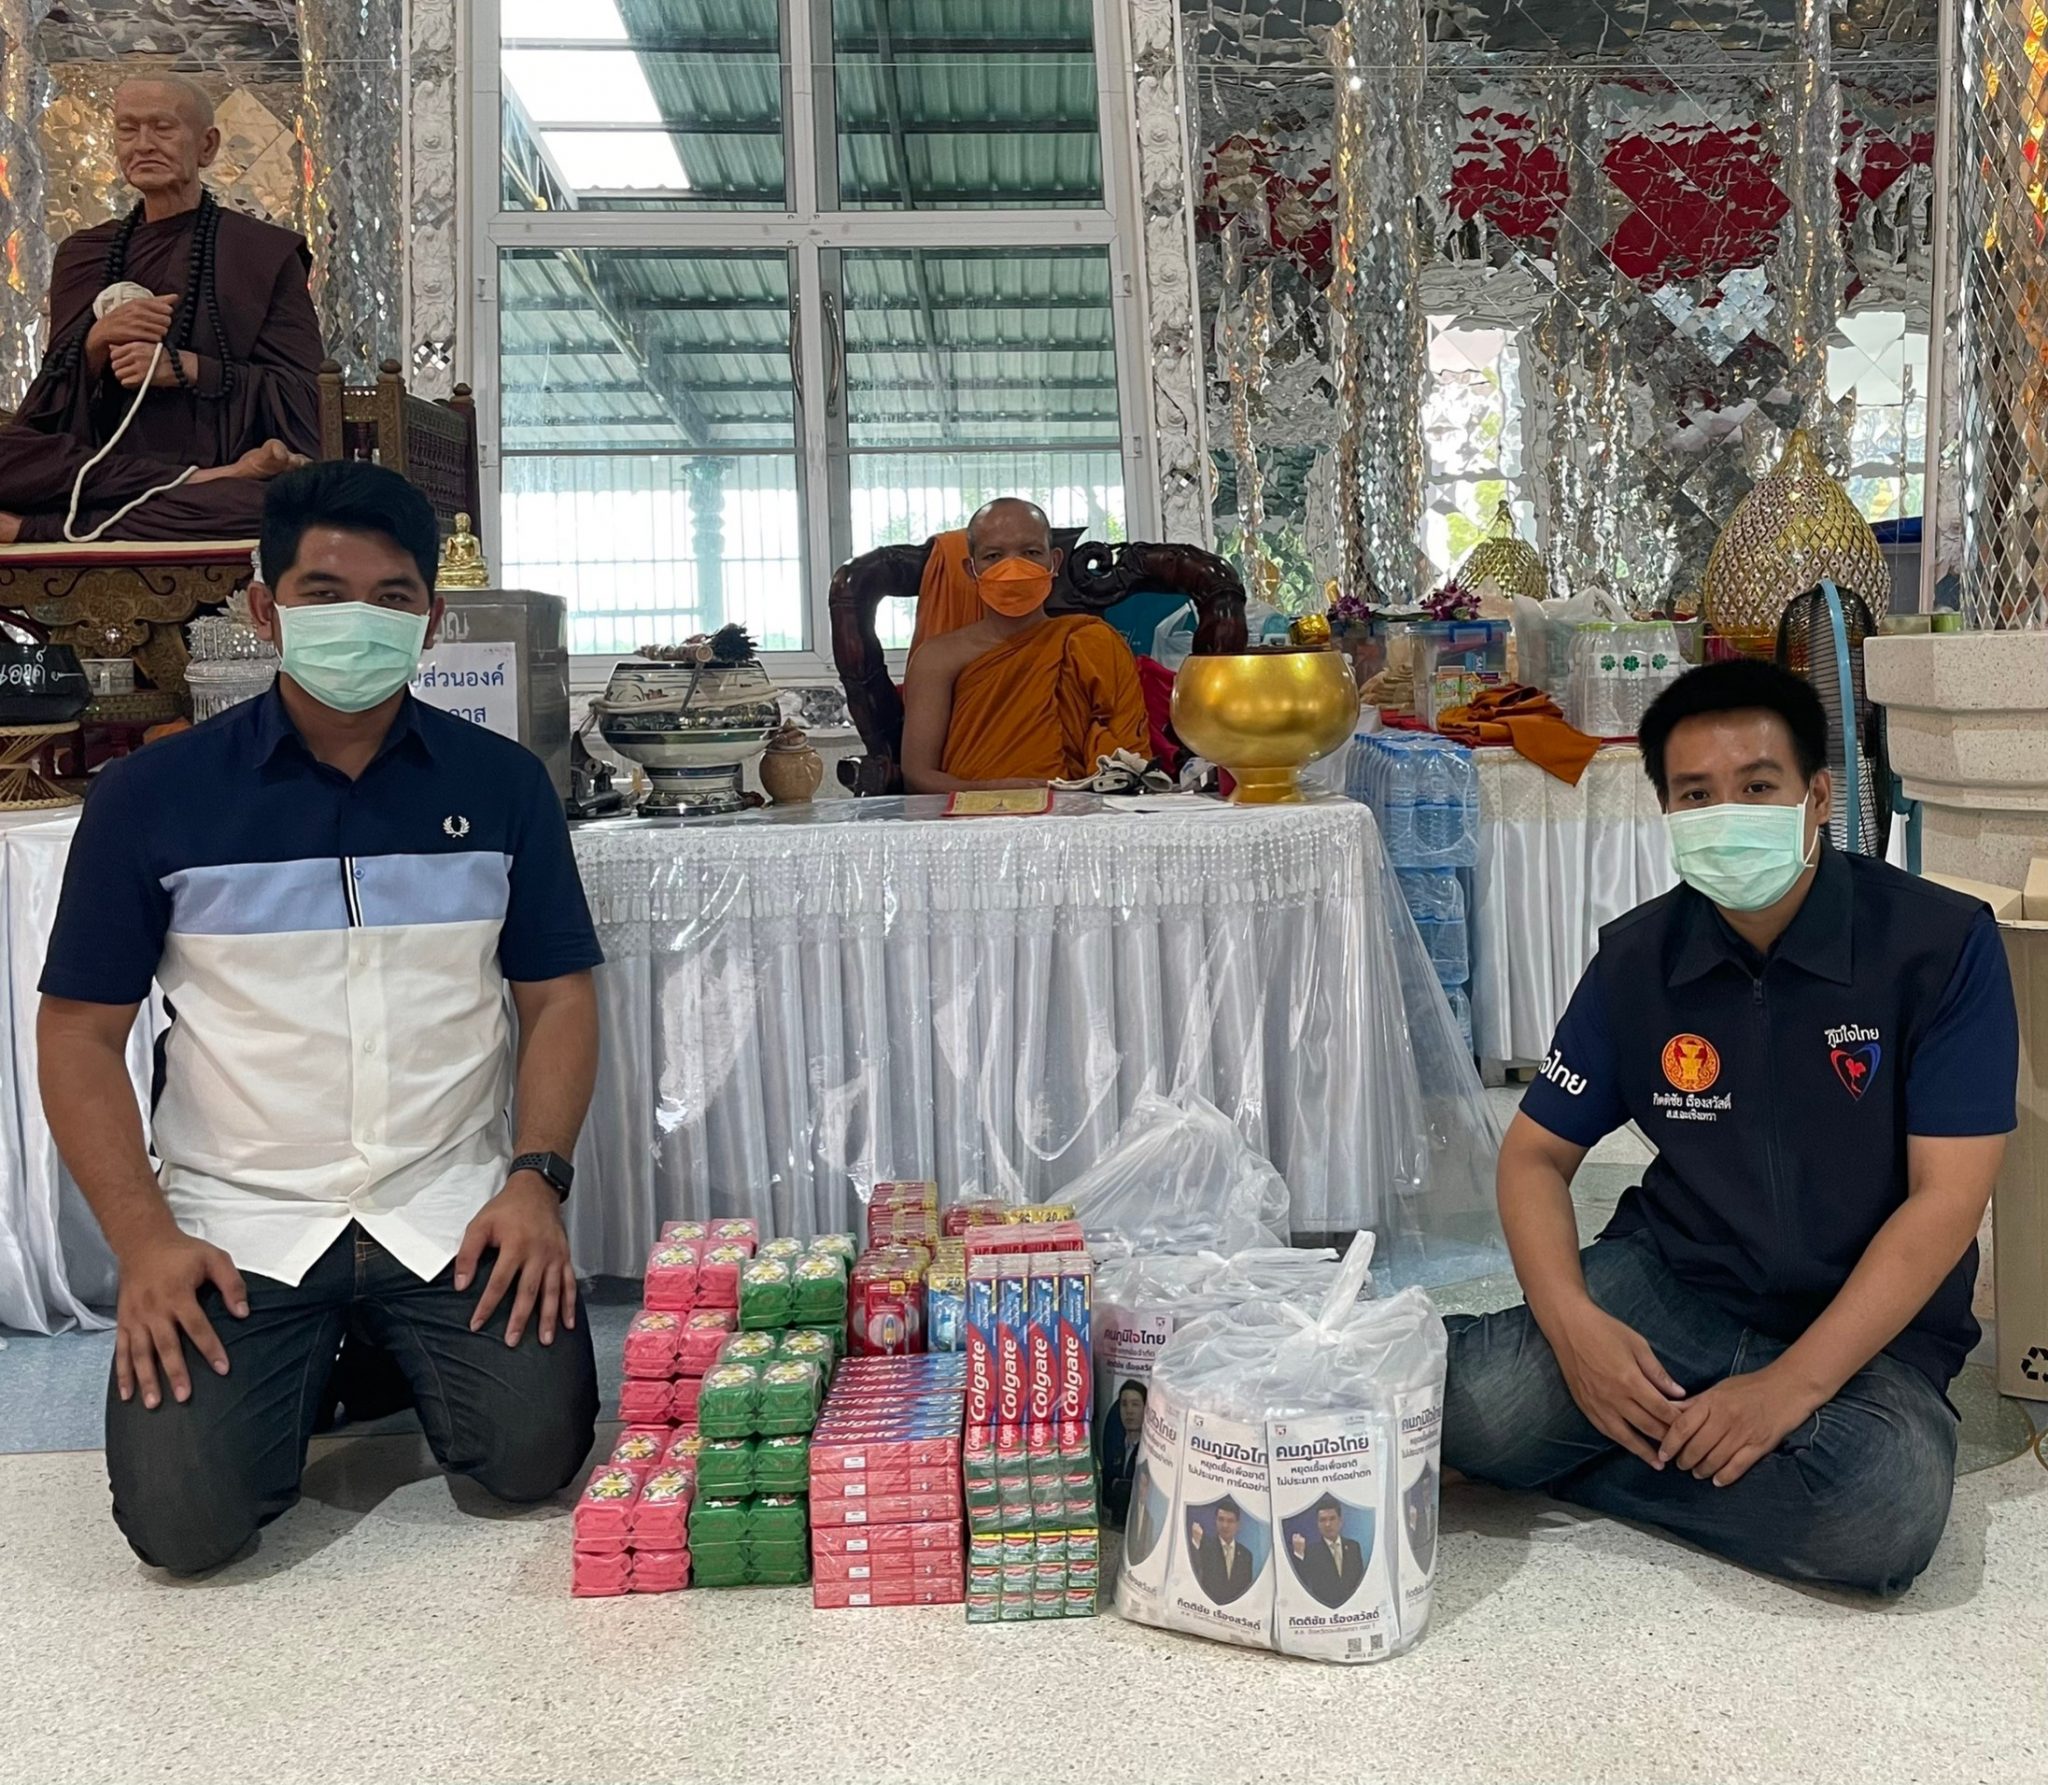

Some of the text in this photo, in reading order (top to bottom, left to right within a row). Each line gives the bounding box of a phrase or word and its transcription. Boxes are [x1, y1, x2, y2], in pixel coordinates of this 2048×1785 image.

[1824, 1023, 1880, 1049] ภูมิใจไทย
[1537, 1049, 1588, 1096] จไทย
[1652, 1091, 1683, 1107] กิตติชัย
[970, 1340, 989, 1421] Colgate
[1001, 1338, 1021, 1420] Colgate
[1032, 1337, 1052, 1418] Colgate
[1063, 1335, 1083, 1417] Colgate
[816, 1431, 899, 1440] Colgate
[821, 1418, 904, 1428] Colgate
[1190, 1435, 1269, 1465] คนภูมิใจไท
[1275, 1435, 1369, 1461] คนภูมิใจไทย
[1288, 1606, 1380, 1626] กิตติชัย เรืองสวัสดิ์
